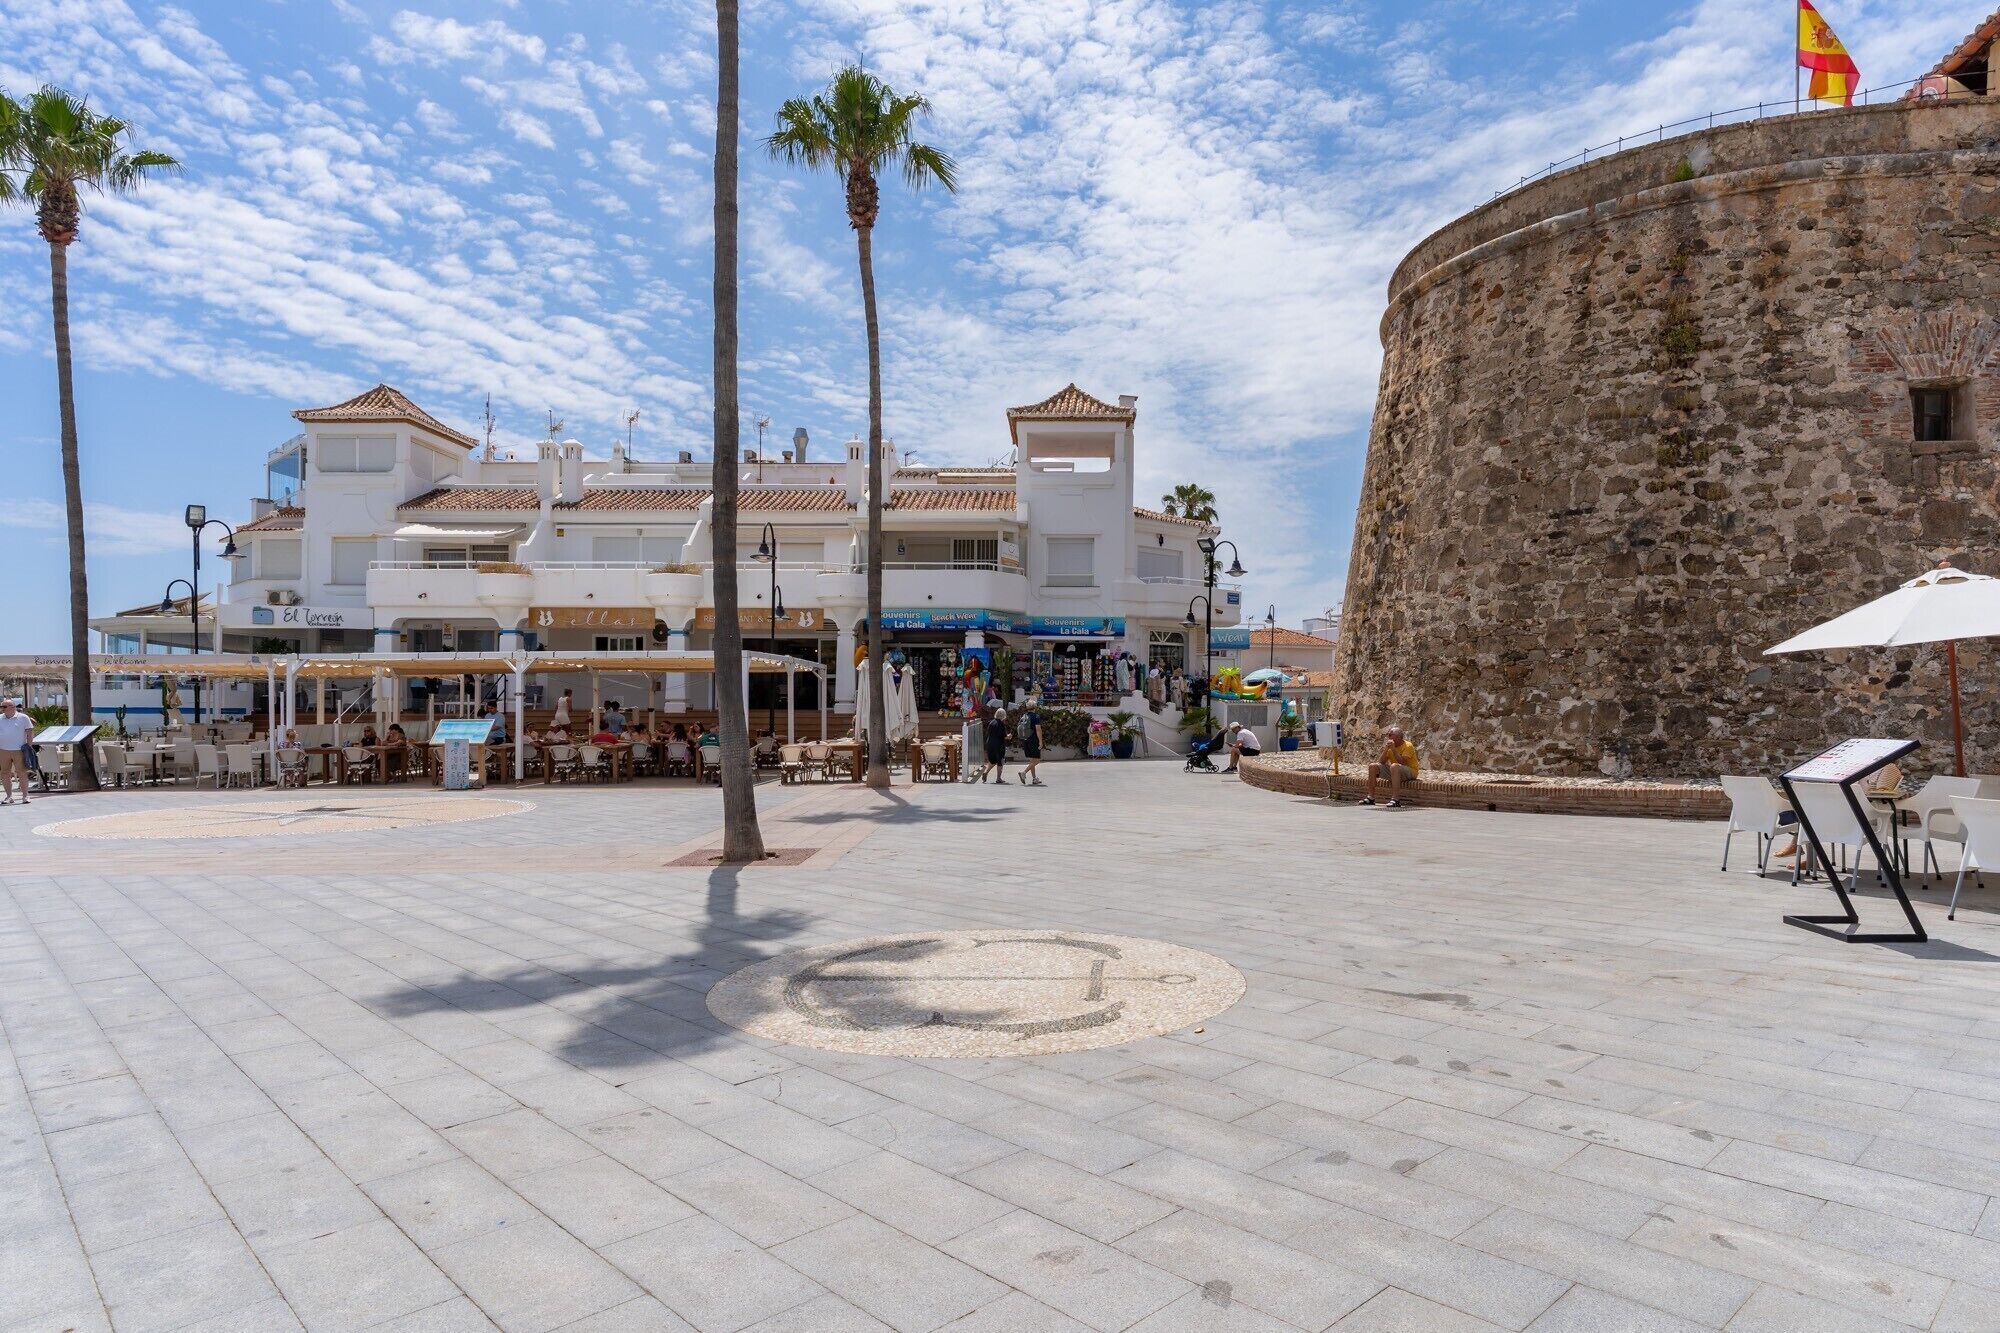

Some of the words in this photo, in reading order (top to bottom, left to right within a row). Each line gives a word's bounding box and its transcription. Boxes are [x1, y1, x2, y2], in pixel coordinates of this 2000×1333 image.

[283, 607, 299, 623] El
[303, 607, 344, 626] Torreón
[562, 610, 642, 626] ellas
[757, 615, 764, 623] &
[894, 620, 905, 629] La
[906, 620, 926, 629] Cala
[1044, 618, 1085, 626] Souvenirs
[1060, 627, 1070, 635] La
[1071, 627, 1090, 635] Cala
[103, 656, 147, 665] Welcome
